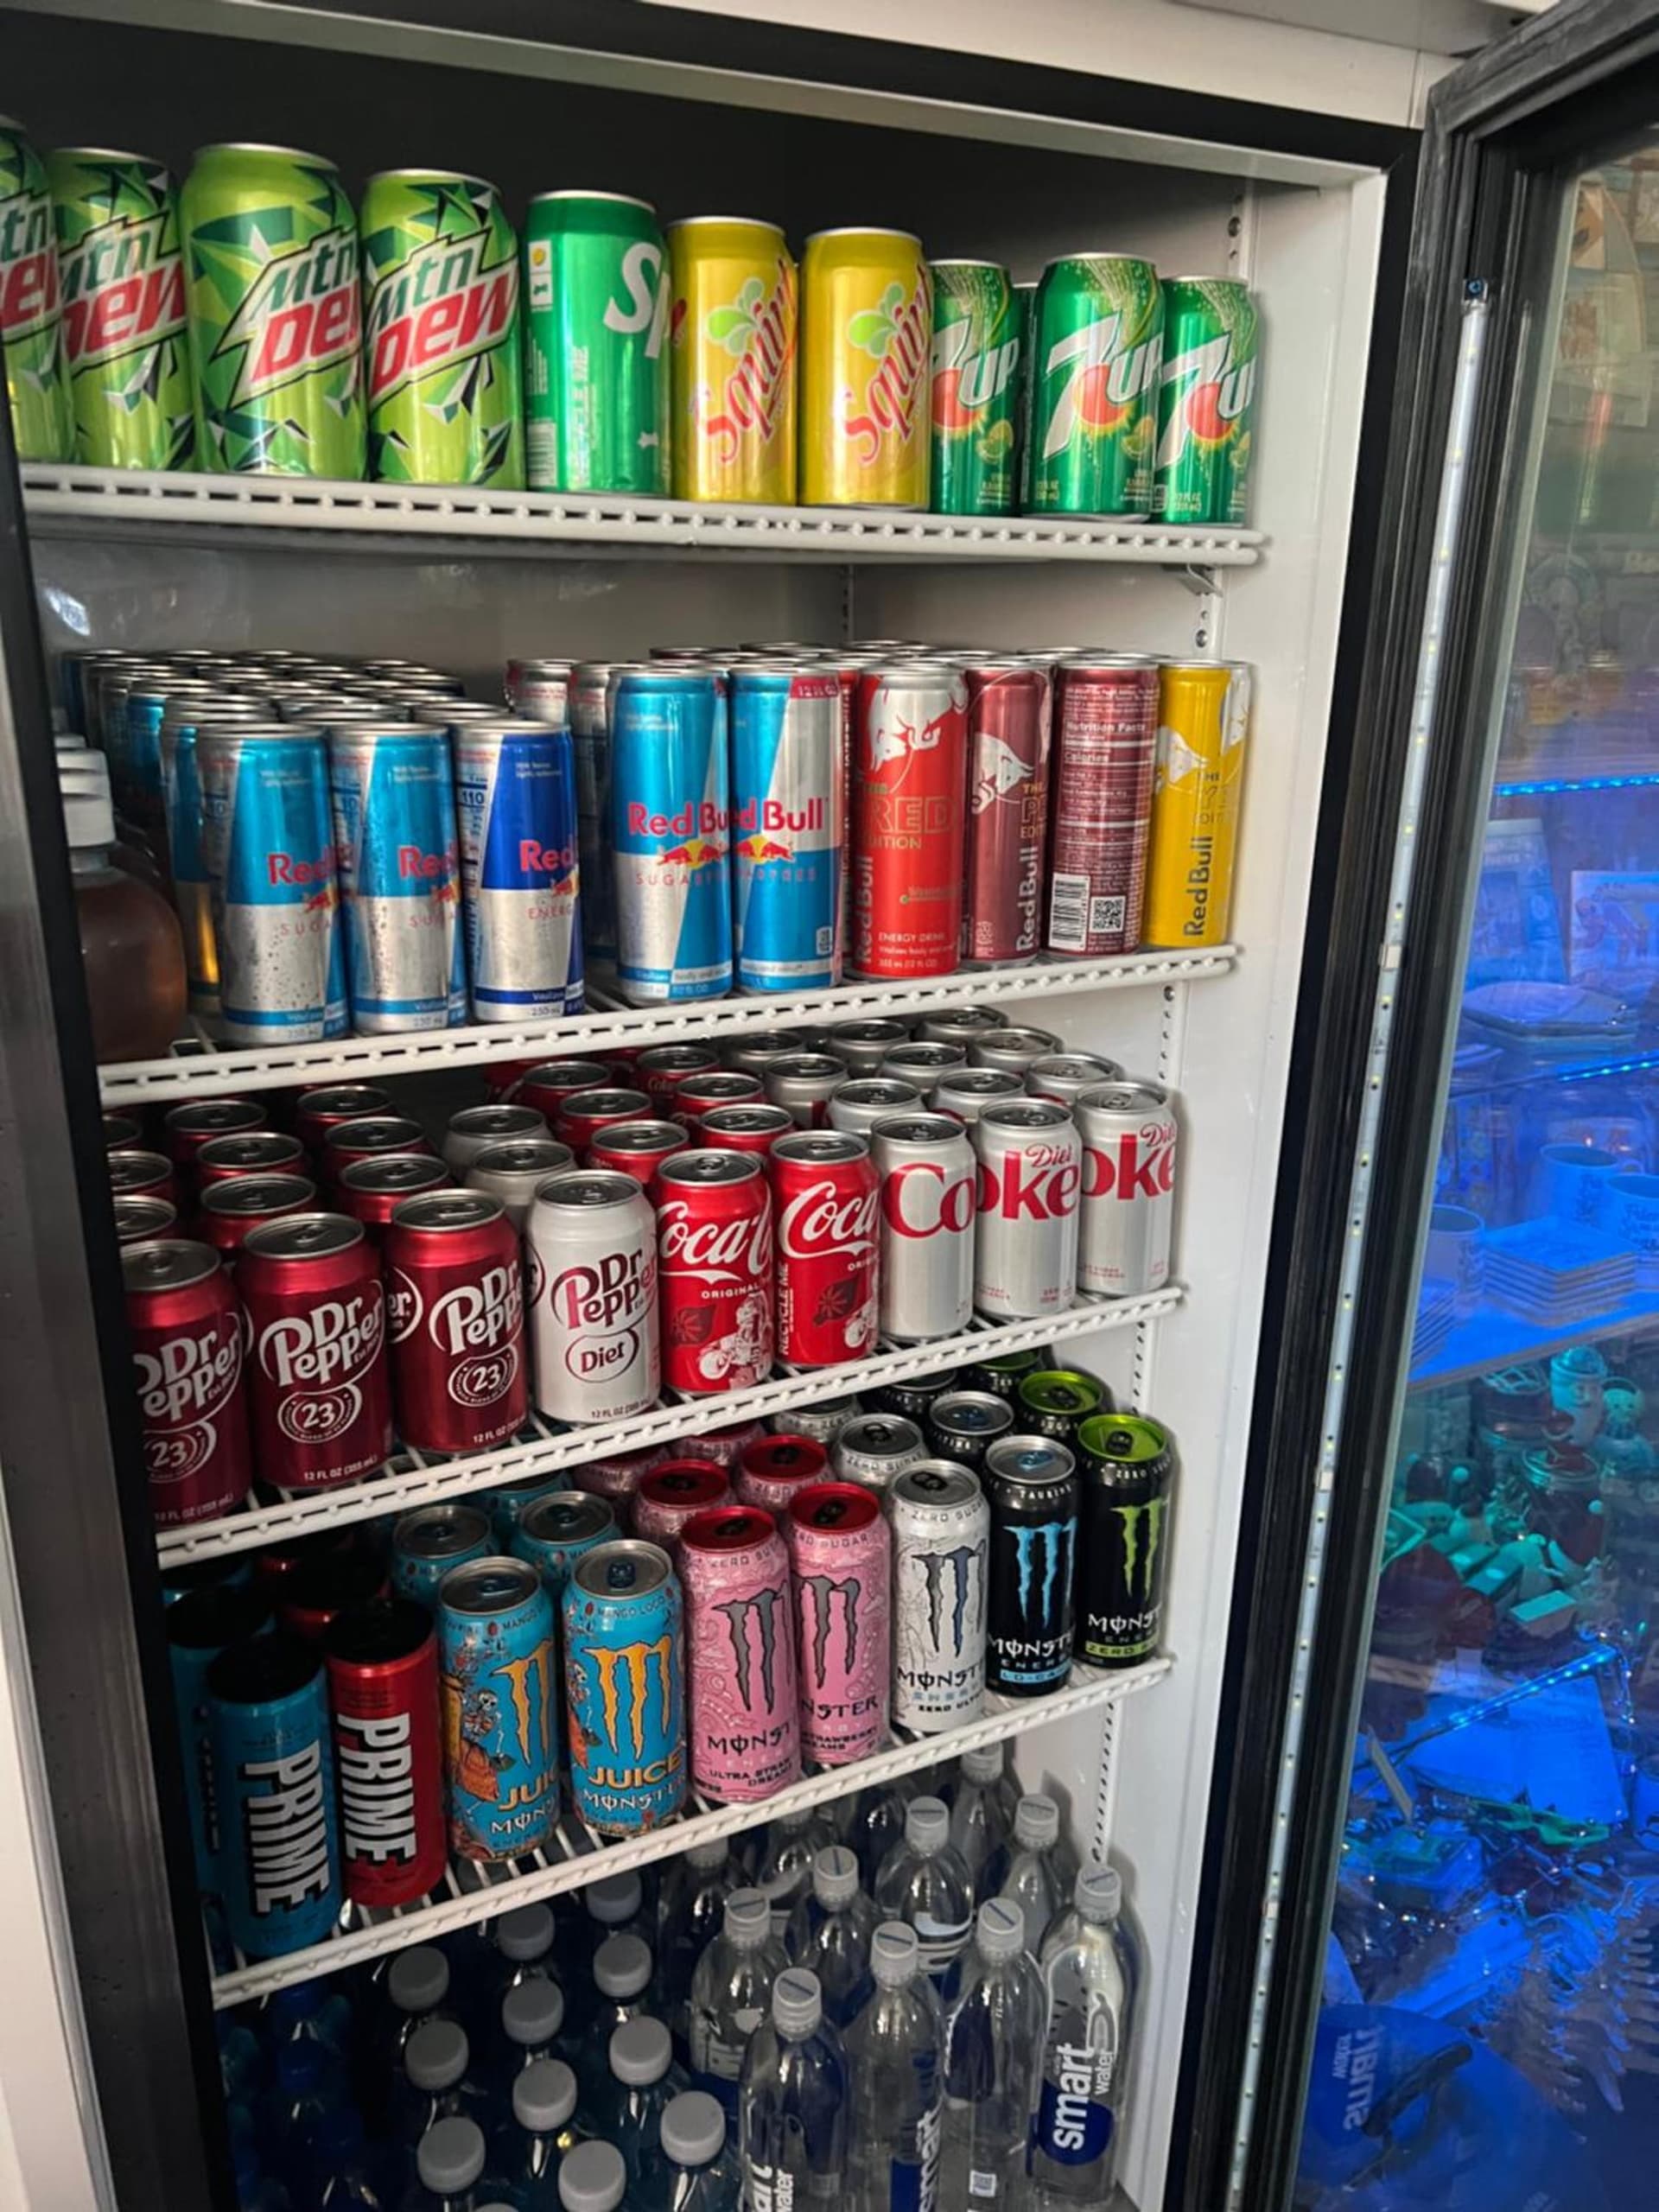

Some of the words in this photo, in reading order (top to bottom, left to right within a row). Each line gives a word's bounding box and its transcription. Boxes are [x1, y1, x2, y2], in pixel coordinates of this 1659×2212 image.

[251, 282, 359, 383] De
[1065, 721, 1115, 733] Nutrition
[462, 791, 486, 805] 110
[762, 798, 823, 833] Bull
[628, 802, 693, 837] Red
[698, 800, 728, 835] Bu
[1019, 846, 1039, 897] Bull
[1189, 836, 1214, 885] Bull
[1015, 899, 1035, 951] Red
[1183, 888, 1208, 936] Red
[1025, 1142, 1071, 1167] Diet
[882, 1163, 976, 1238] Co
[976, 1150, 1079, 1221] oke
[600, 1249, 643, 1294] Dr
[701, 1283, 760, 1300] ORIGINAL
[310, 1297, 363, 1349] Dr
[160, 1331, 218, 1383] Dr
[259, 1299, 383, 1387] Pepper
[581, 1341, 626, 1373] Diet
[473, 1364, 501, 1392] 23
[301, 1402, 336, 1428] 23
[151, 1440, 188, 1468] 23
[473, 1433, 484, 1443] 12
[485, 1430, 495, 1440] FL
[304, 1471, 315, 1481] 12
[316, 1470, 327, 1480] FL
[329, 1466, 342, 1478] OZ
[897, 1662, 981, 1692] MONST
[802, 1695, 879, 1720] NSTER
[337, 1713, 416, 1861] PRIME
[588, 1751, 683, 1789] JUICE
[709, 1769, 750, 1779] ULTRA
[245, 1739, 330, 1913] PRIME
[1094, 2049, 1113, 2095] water
[1052, 2043, 1095, 2151] smart
